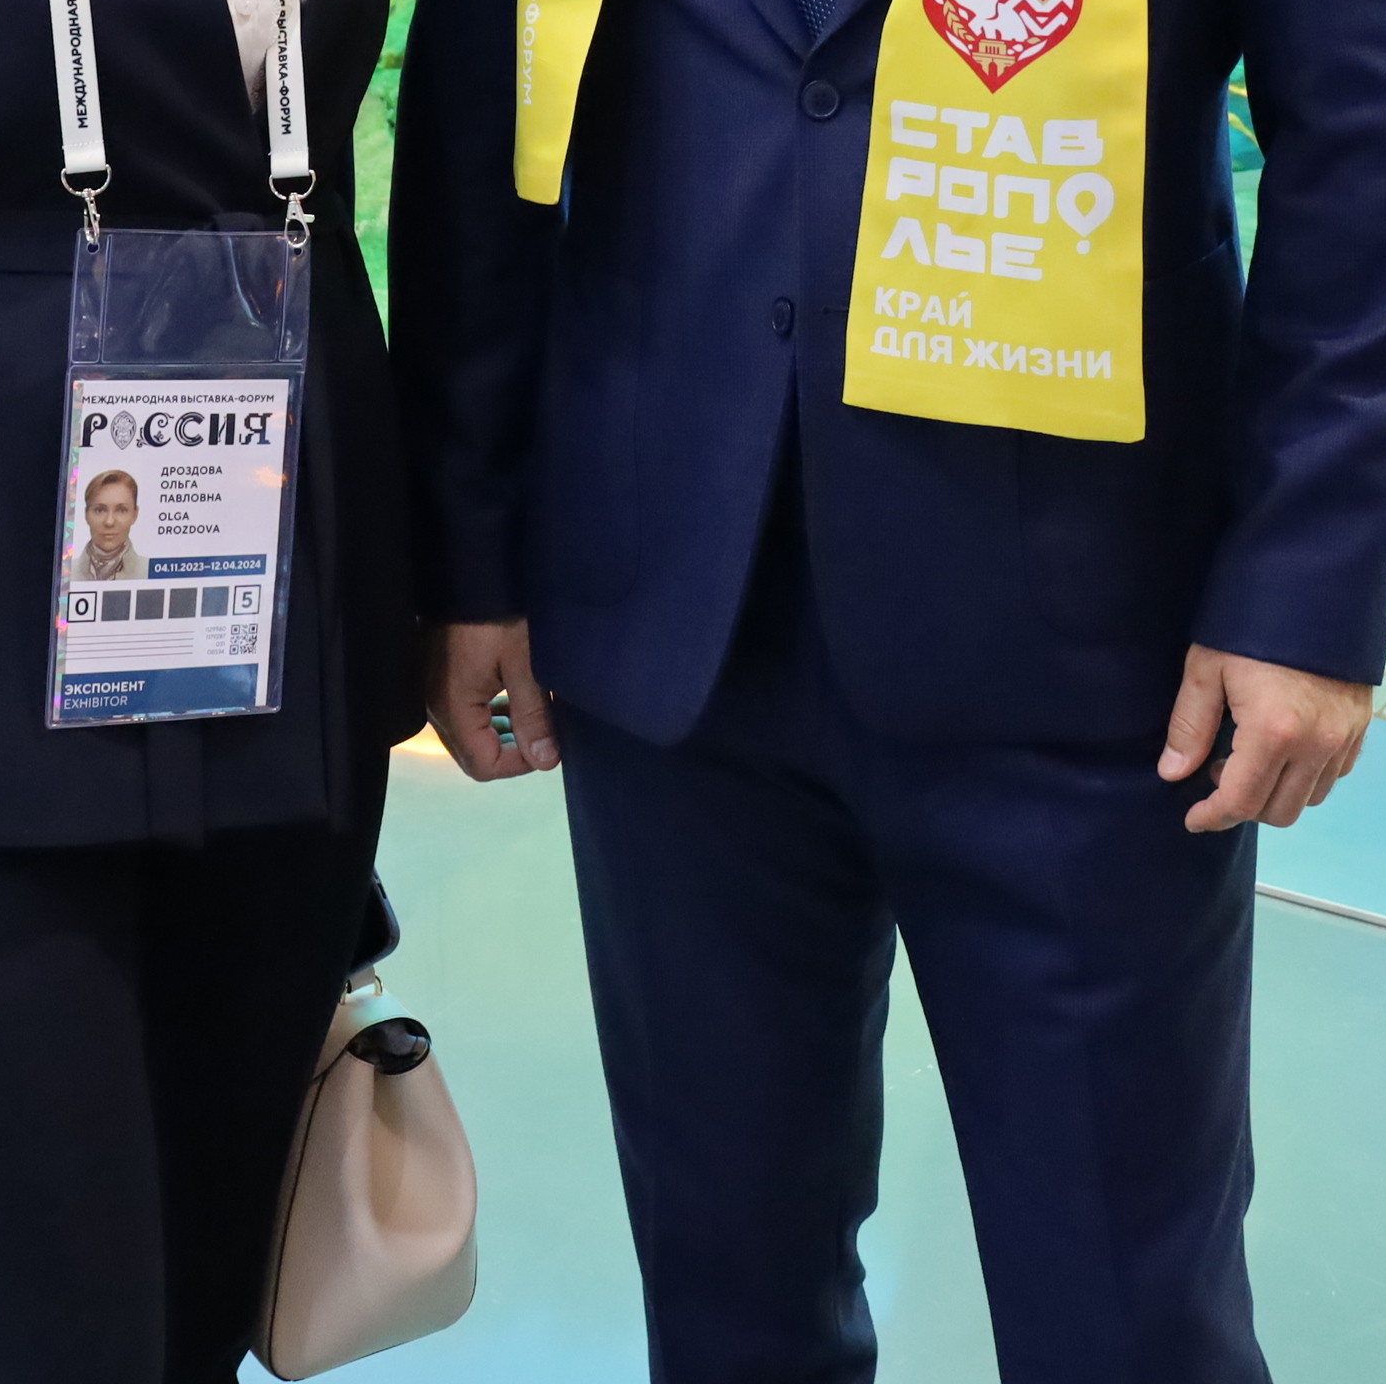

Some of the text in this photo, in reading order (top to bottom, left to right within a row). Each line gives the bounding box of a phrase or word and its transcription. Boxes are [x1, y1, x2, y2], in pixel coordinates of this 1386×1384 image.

[890, 100, 1103, 166] СТАВ
[880, 217, 1044, 281] ЛЬЕ
[874, 286, 972, 329] КРАЙ
[870, 326, 1112, 379] ДЛЯ ЖИЗНИ
[82, 395, 274, 405] МЕЖДУНАРОДНАЯ ВЫСТАВКА-ФОРУМ
[80, 410, 273, 450] РОССИЯ
[161, 466, 222, 477] ДРОЗДОВА
[161, 480, 198, 489] ОЛЬГА
[160, 493, 221, 503] ПАВЛОВНА
[158, 512, 189, 521] OLGA
[158, 525, 220, 535] DROZDOVA
[242, 591, 253, 608] 5
[64, 681, 145, 695] ЭКСПОНЕНТ
[64, 696, 128, 710] EXHIBITOR
